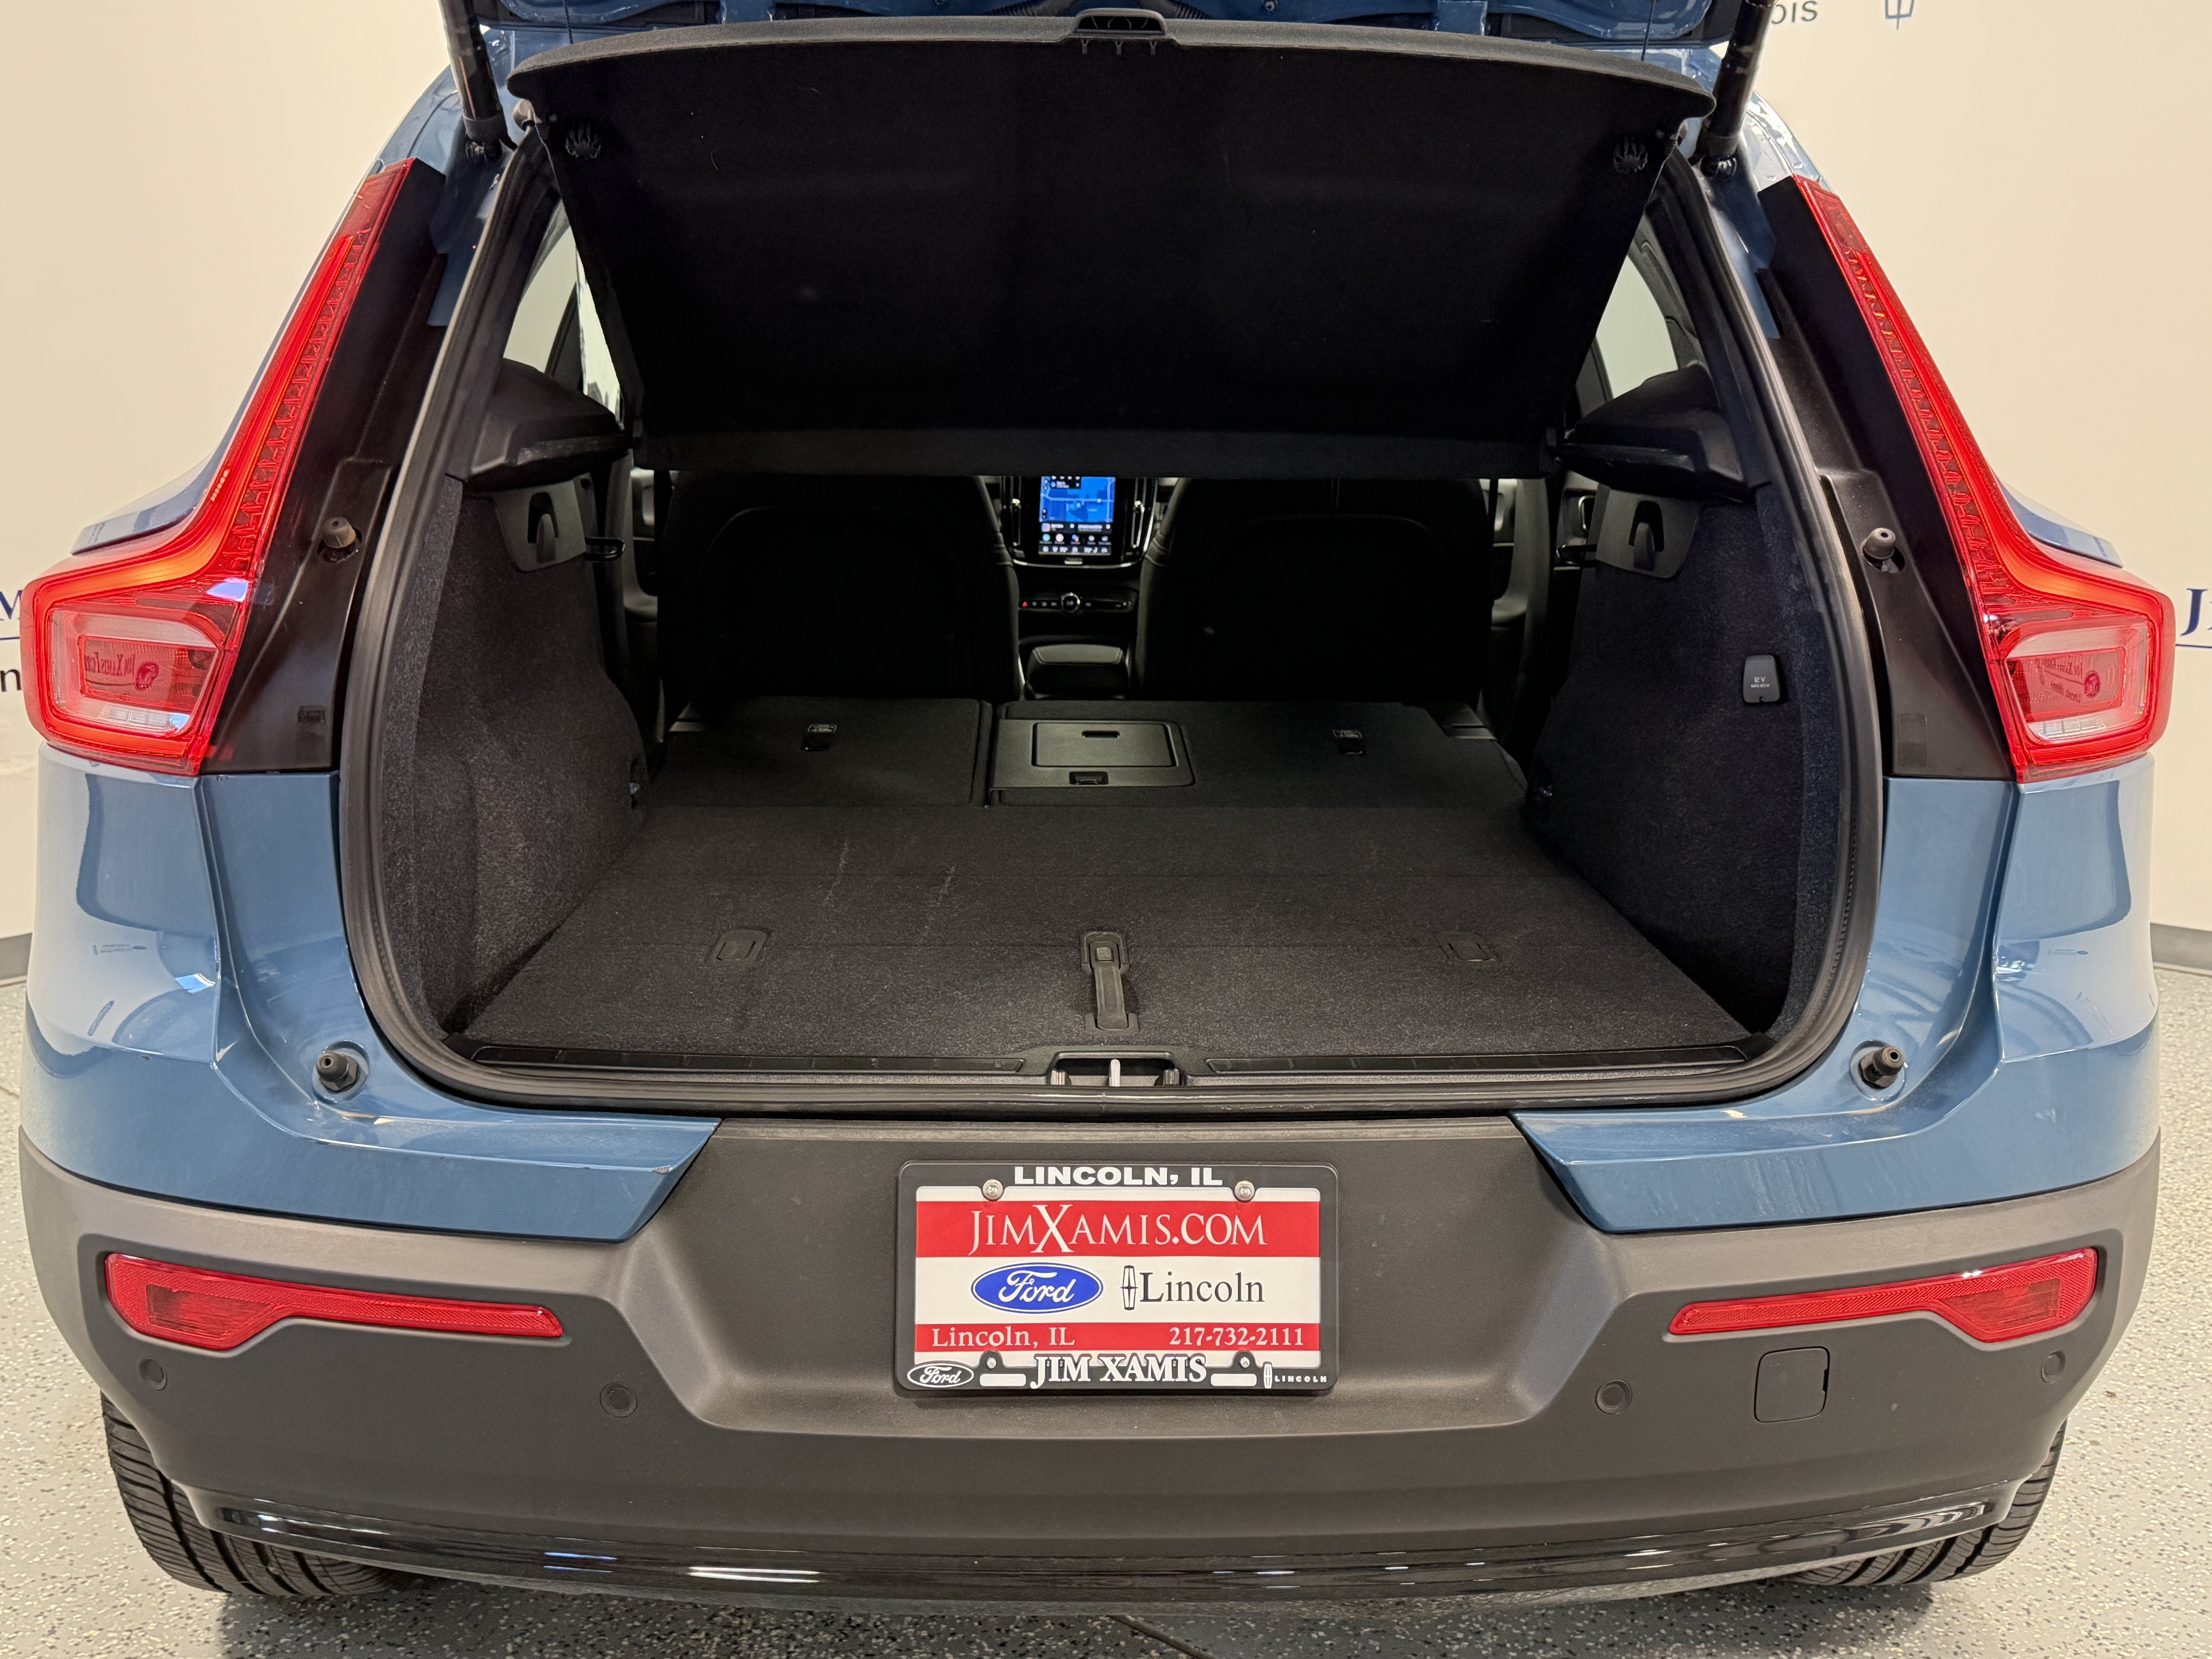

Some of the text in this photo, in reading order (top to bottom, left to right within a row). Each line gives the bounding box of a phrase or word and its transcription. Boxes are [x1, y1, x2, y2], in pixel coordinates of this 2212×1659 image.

[1015, 1166, 1223, 1185] LINCOLN, IL
[998, 1271, 1076, 1304] Ford
[1139, 1272, 1266, 1302] Lincoln
[932, 1327, 1075, 1349] Lincoln, IL
[1170, 1327, 1304, 1346] 217-732-2111
[920, 1367, 961, 1384] Ford
[1030, 1355, 1207, 1389] JIM XAMIS
